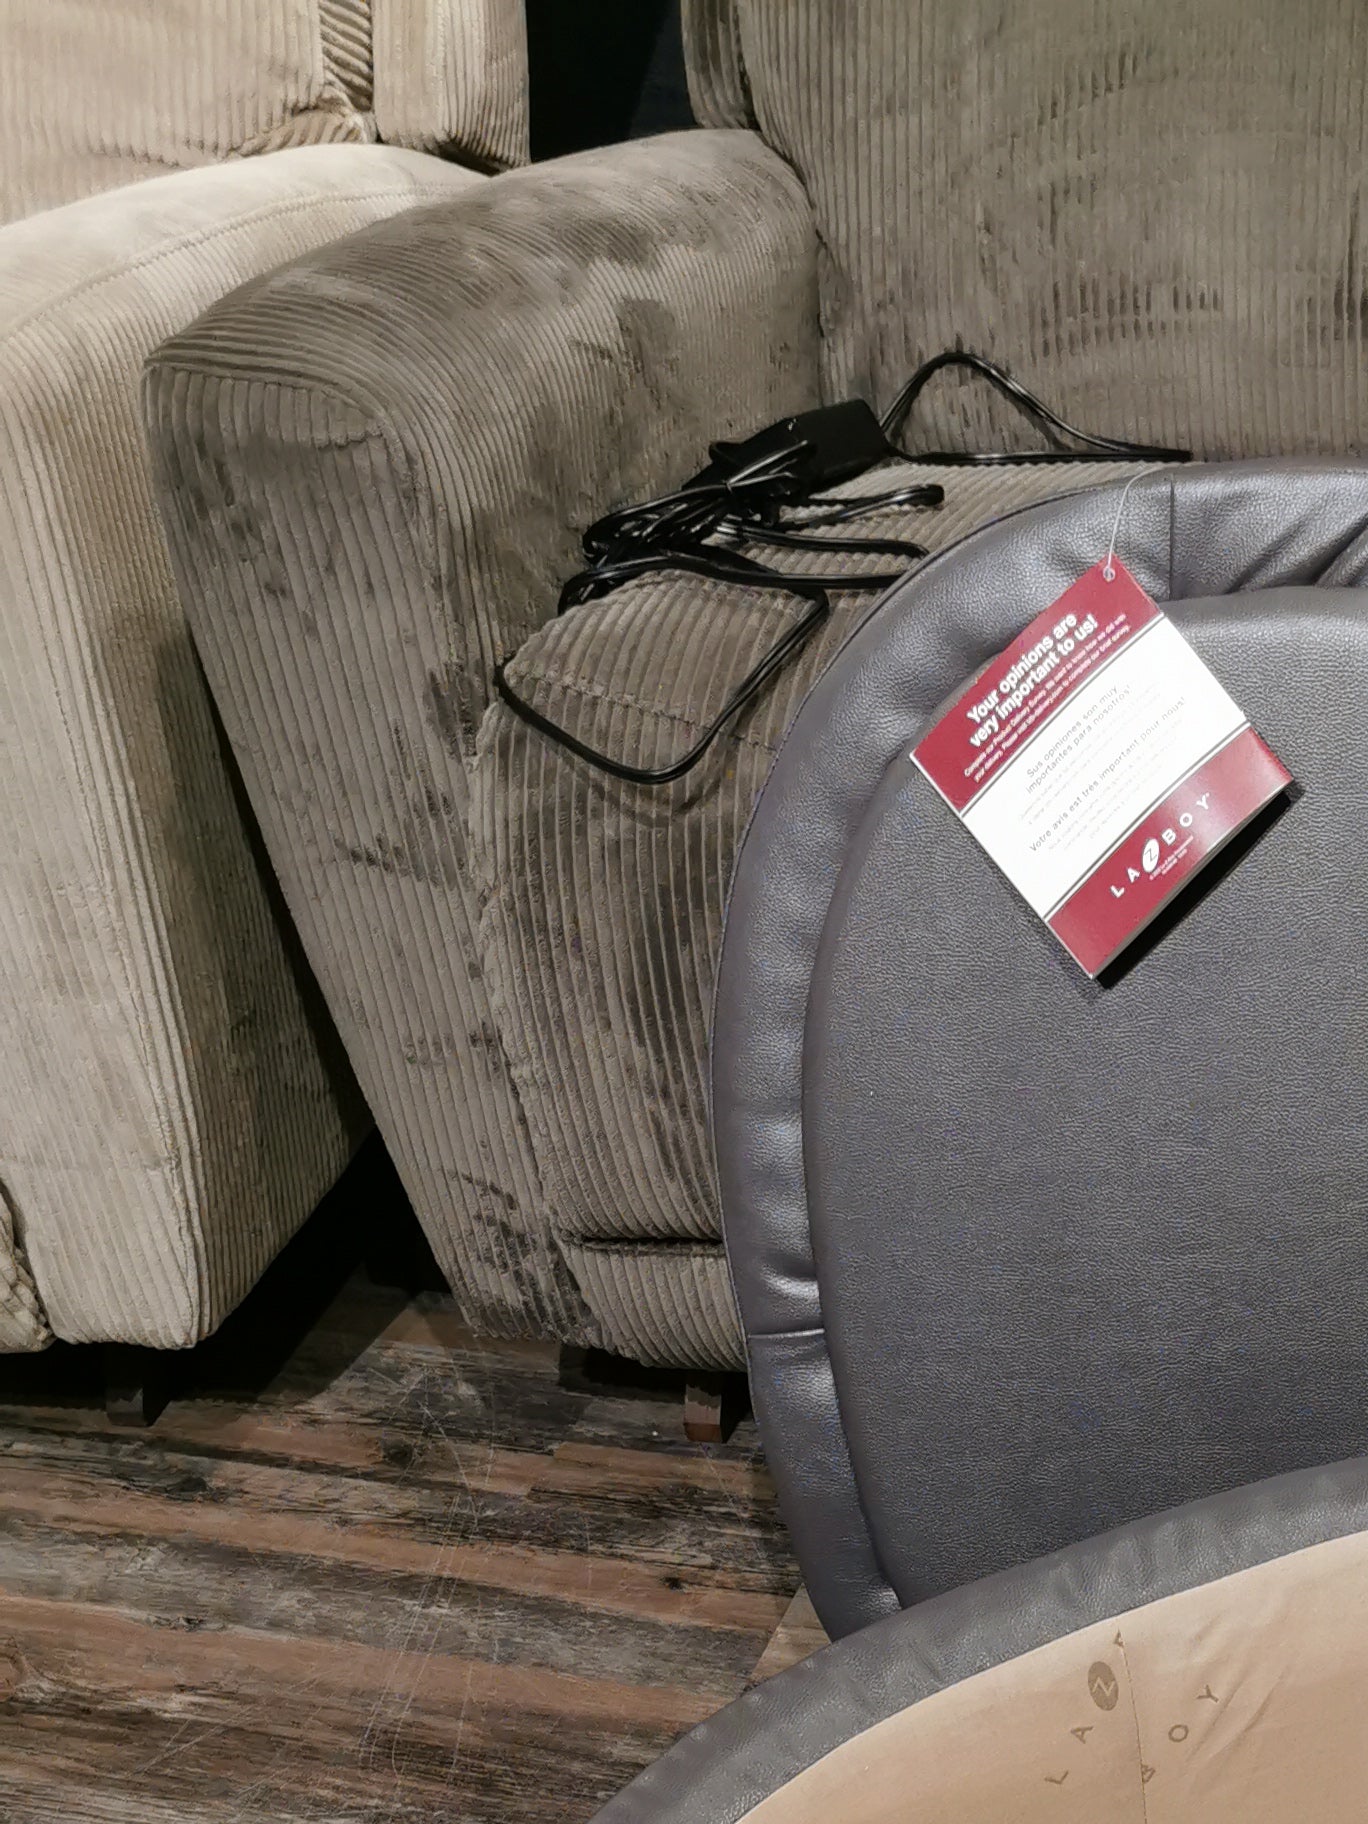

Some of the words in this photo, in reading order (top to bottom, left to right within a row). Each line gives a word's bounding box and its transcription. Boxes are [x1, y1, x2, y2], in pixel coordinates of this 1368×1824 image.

[966, 689, 999, 723] Your
[999, 636, 1054, 693] opinions
[1053, 614, 1077, 639] are
[969, 714, 999, 747] very
[998, 650, 1060, 720] important
[1056, 638, 1075, 656] to
[1074, 613, 1098, 641] us!
[1025, 744, 1073, 794] importantes
[1073, 724, 1093, 748] para
[1026, 759, 1043, 778] Sus
[1043, 721, 1082, 762] opiniones
[1029, 829, 1052, 852] Votre
[1051, 812, 1069, 831] avis
[1069, 796, 1083, 813] est
[1099, 739, 1139, 781] important
